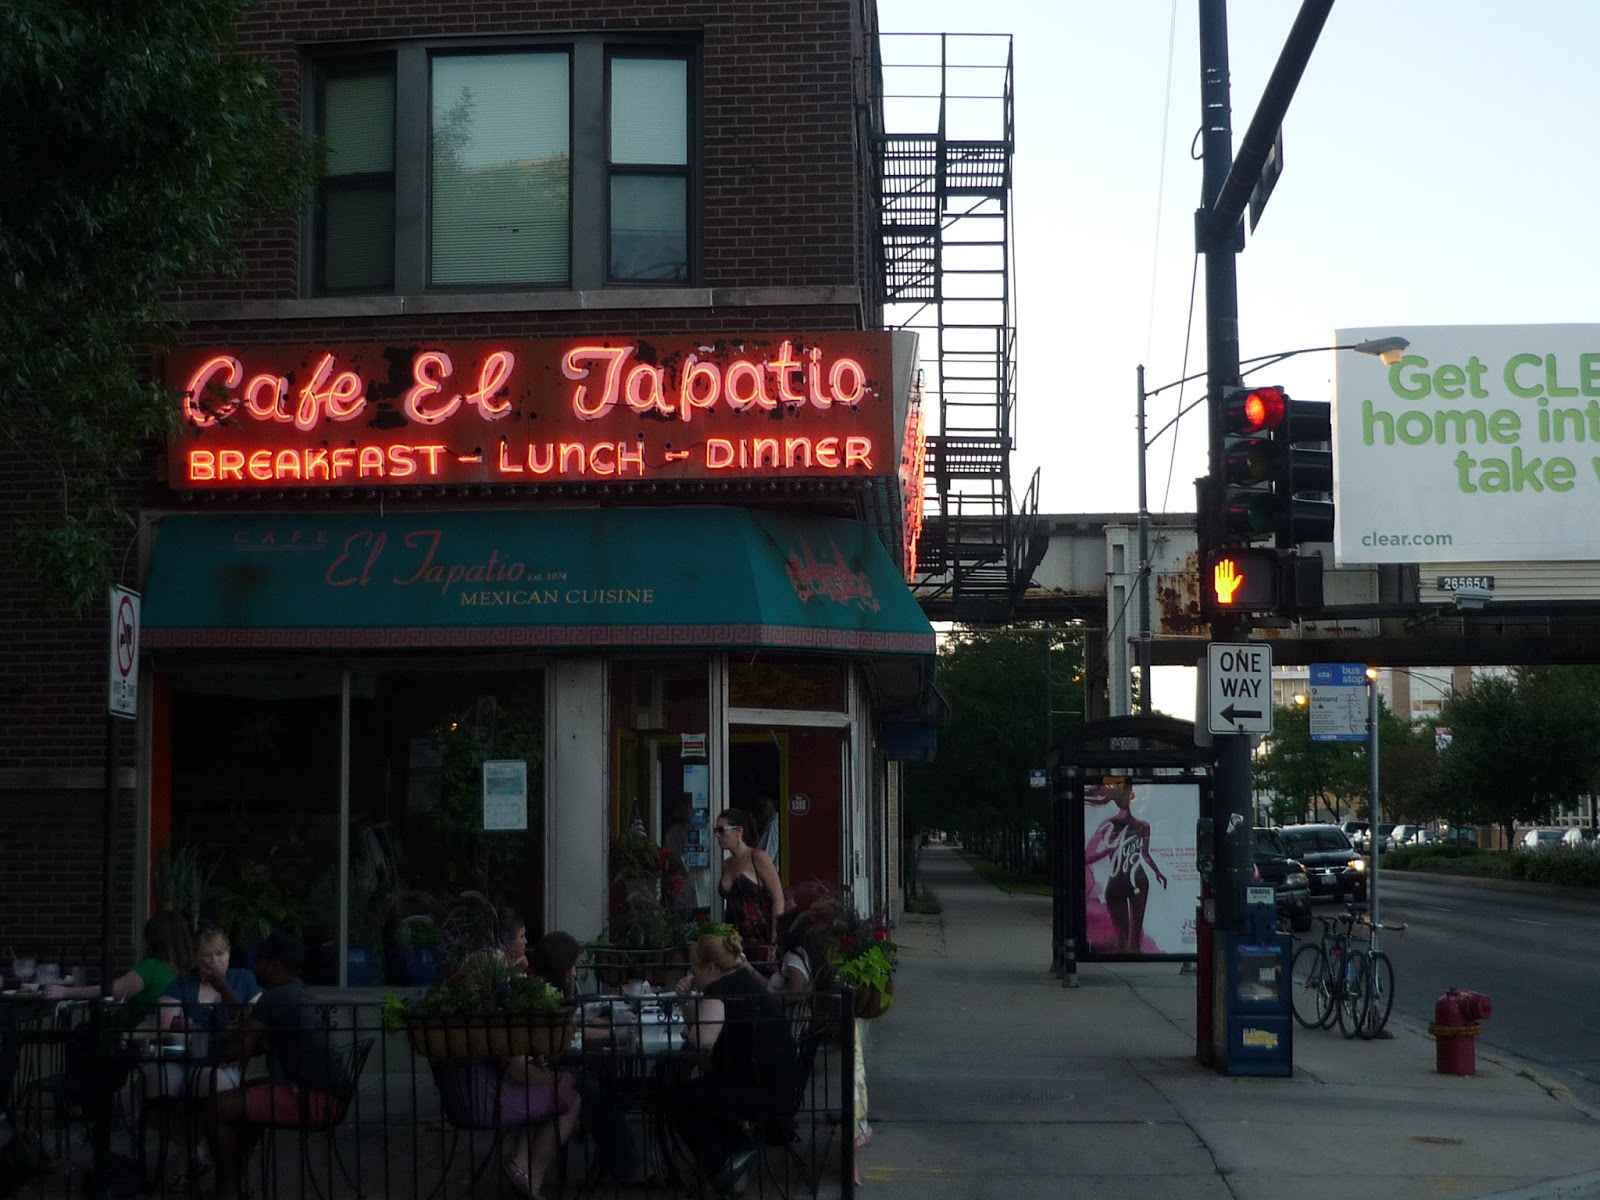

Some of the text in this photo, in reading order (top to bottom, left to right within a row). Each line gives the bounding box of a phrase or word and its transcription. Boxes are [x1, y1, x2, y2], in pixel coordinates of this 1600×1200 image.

[184, 340, 867, 431] Cafe El Tapatio
[1388, 353, 1600, 400] Get CLE
[1361, 397, 1600, 446] home int
[189, 444, 447, 481] BREAKFAST
[499, 440, 645, 476] LUNCH
[706, 437, 873, 470] DINNER
[1454, 446, 1577, 494] take
[1361, 532, 1453, 547] clear.com
[325, 529, 389, 587] El
[392, 528, 526, 597] Tapatio
[1443, 577, 1489, 591] 265654
[460, 588, 655, 606] MEXICAN CUISINE
[1219, 651, 1261, 673] ONE
[1342, 666, 1361, 675] bus
[1221, 677, 1262, 698] WAY
[1342, 676, 1364, 684] stop
